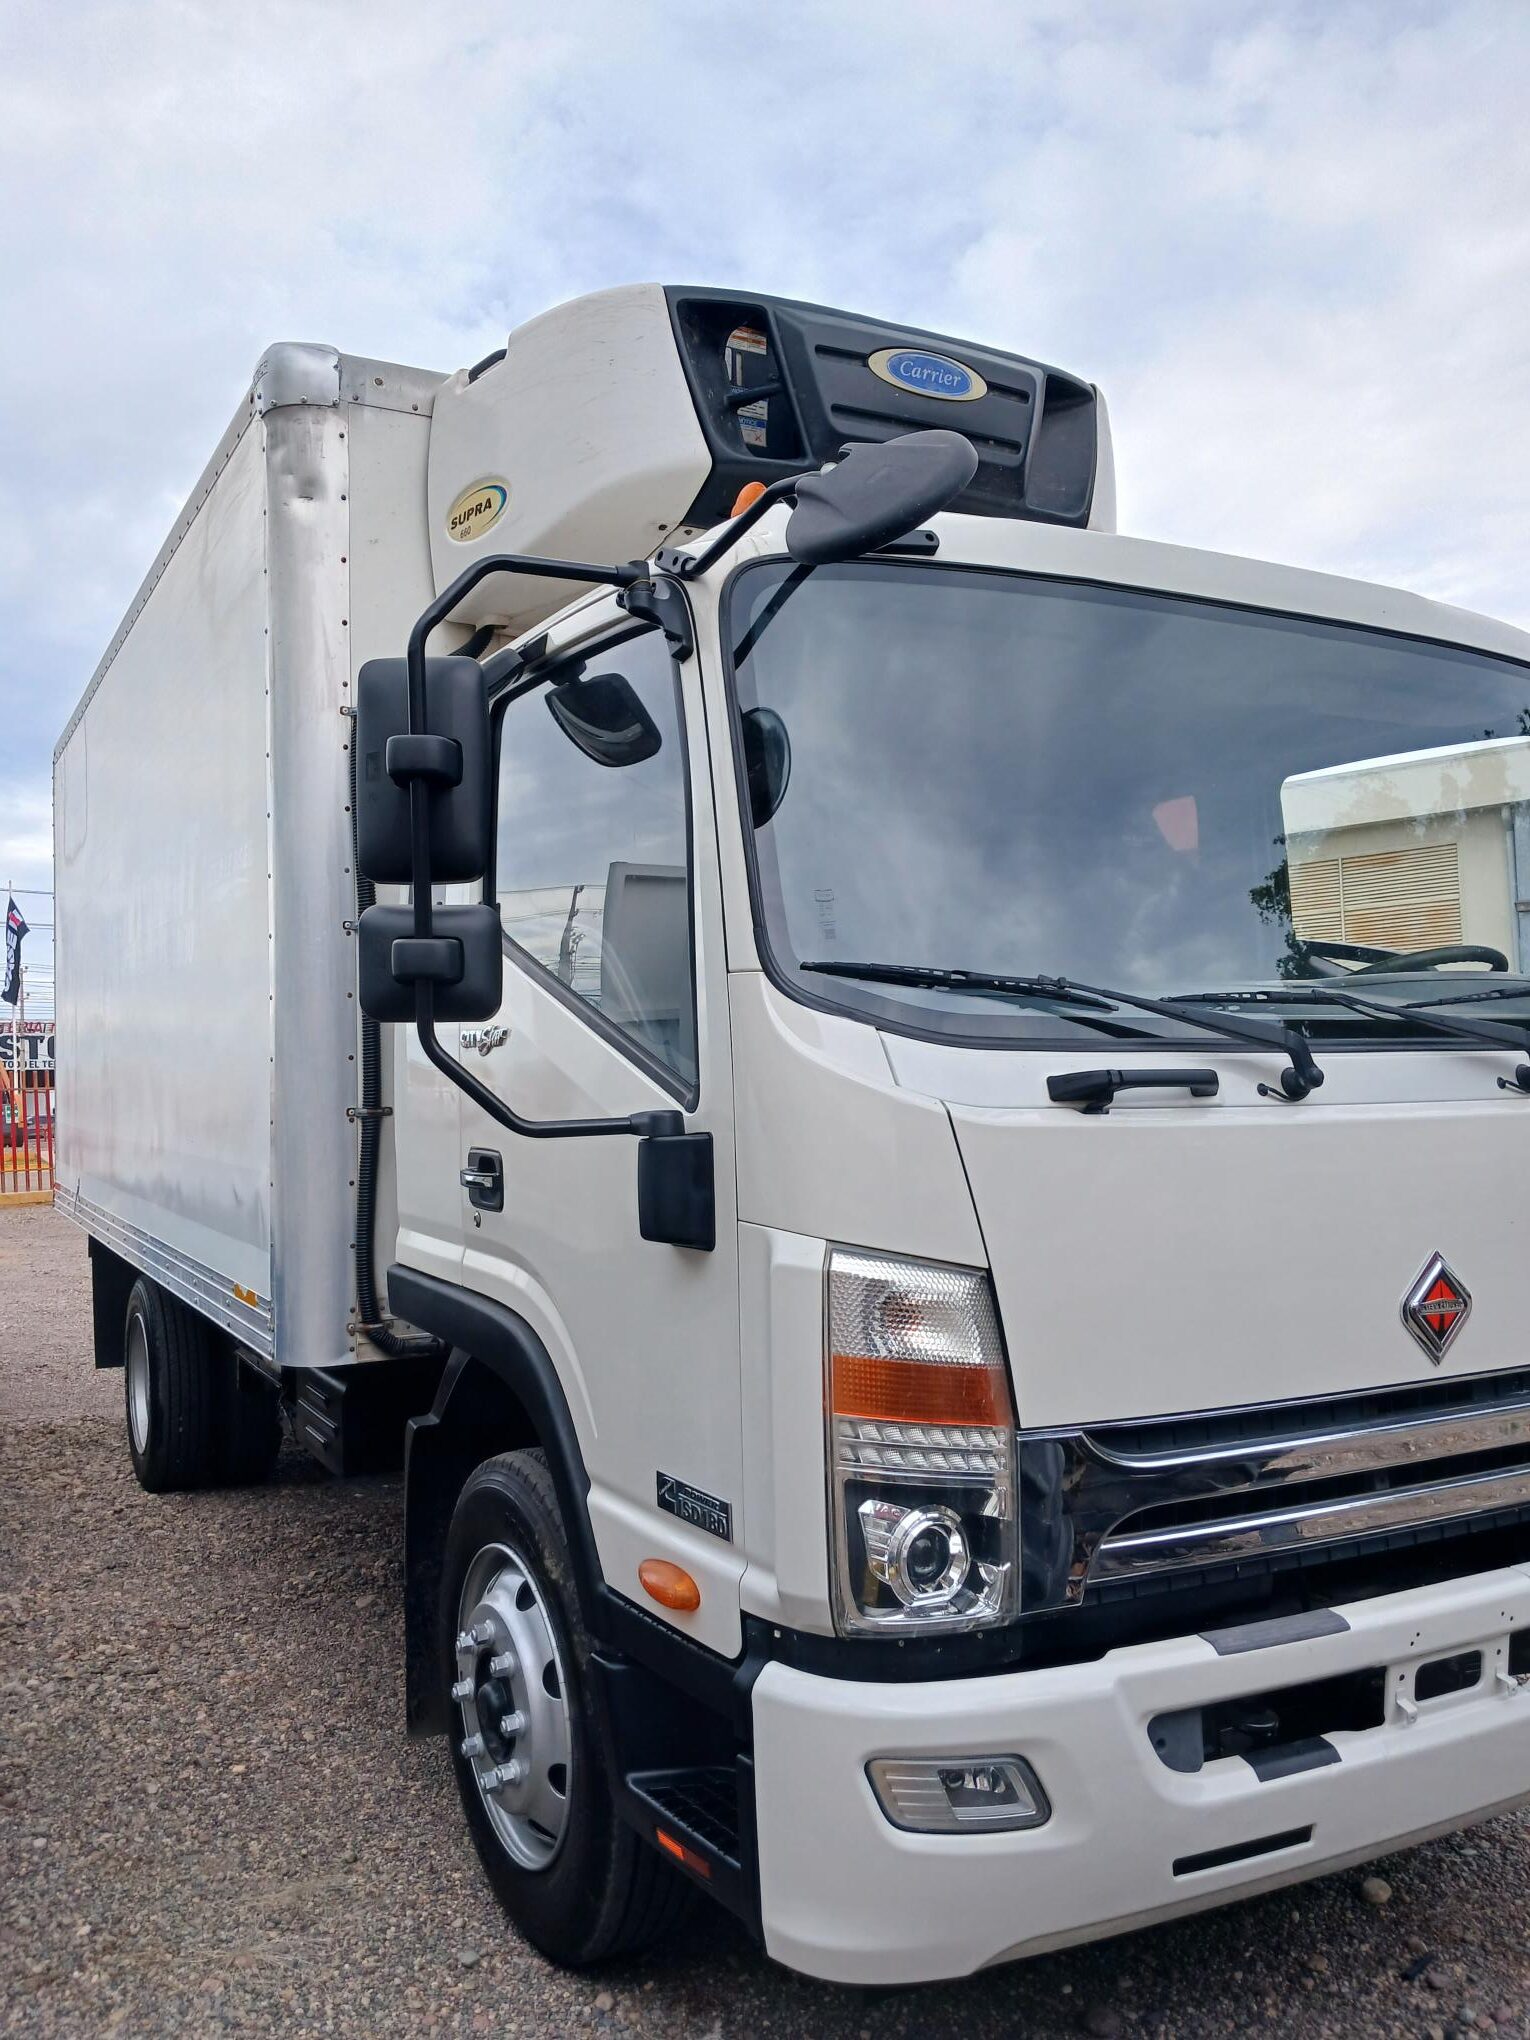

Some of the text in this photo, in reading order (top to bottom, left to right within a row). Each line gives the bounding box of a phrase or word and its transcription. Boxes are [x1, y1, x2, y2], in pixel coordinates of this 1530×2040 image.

[899, 360, 962, 387] Carrier
[450, 497, 493, 531] SUPRA
[29, 1060, 40, 1069] EL
[42, 1060, 56, 1069] TE
